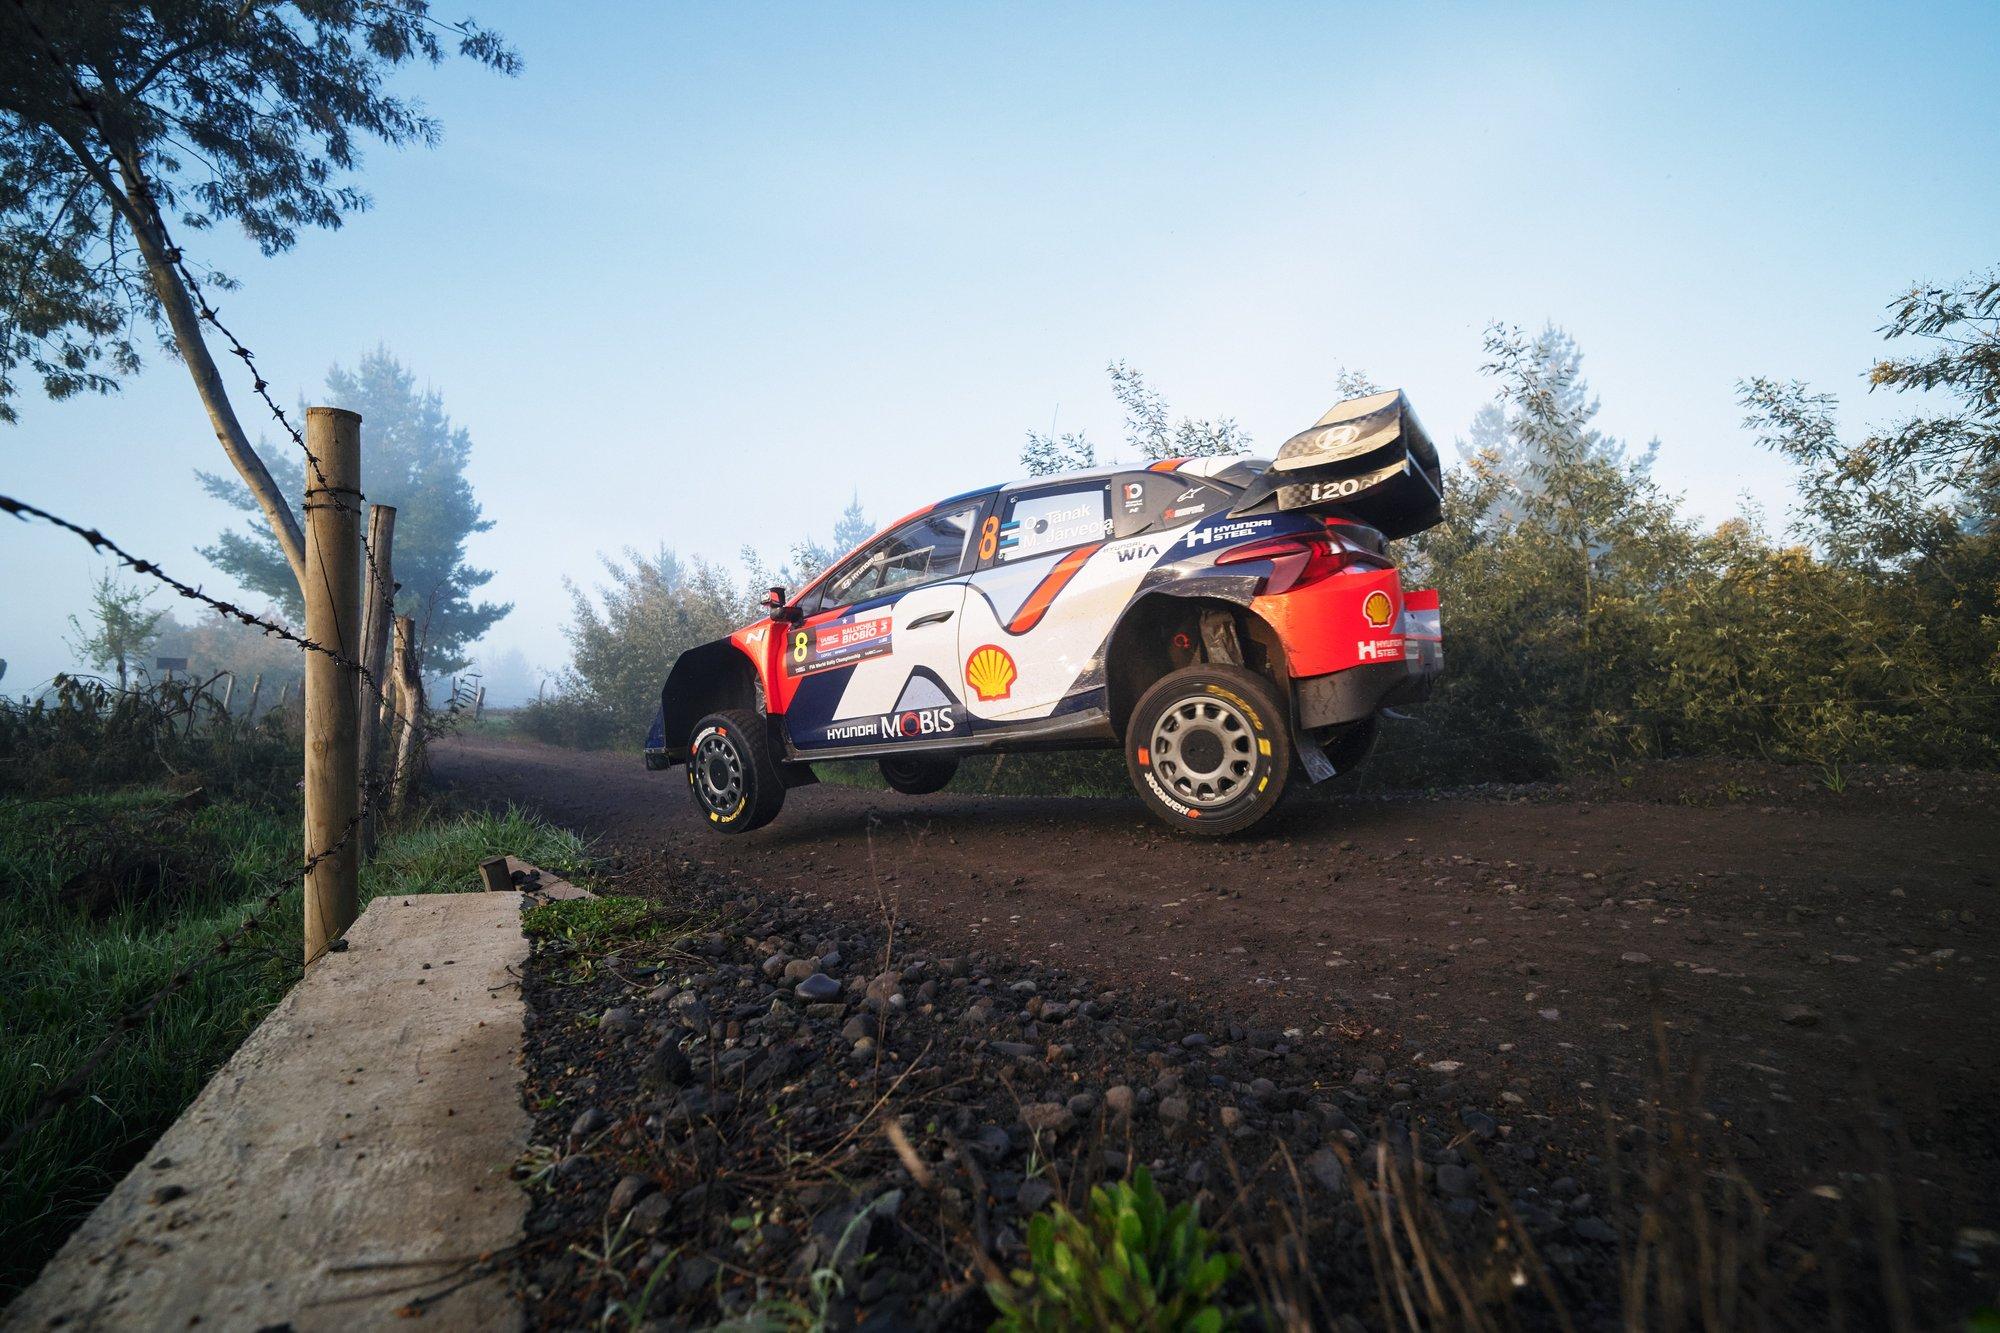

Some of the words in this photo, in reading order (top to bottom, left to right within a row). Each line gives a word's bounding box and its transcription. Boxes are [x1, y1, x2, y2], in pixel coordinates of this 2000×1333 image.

[1311, 479, 1359, 501] i20
[1213, 519, 1272, 533] HYUNDAI
[1213, 528, 1257, 542] STEEL
[979, 516, 999, 560] 8
[851, 557, 875, 581] HYUNDAI
[793, 632, 808, 662] 8
[827, 724, 878, 741] HYUNDAI
[880, 707, 955, 739] MOBIS
